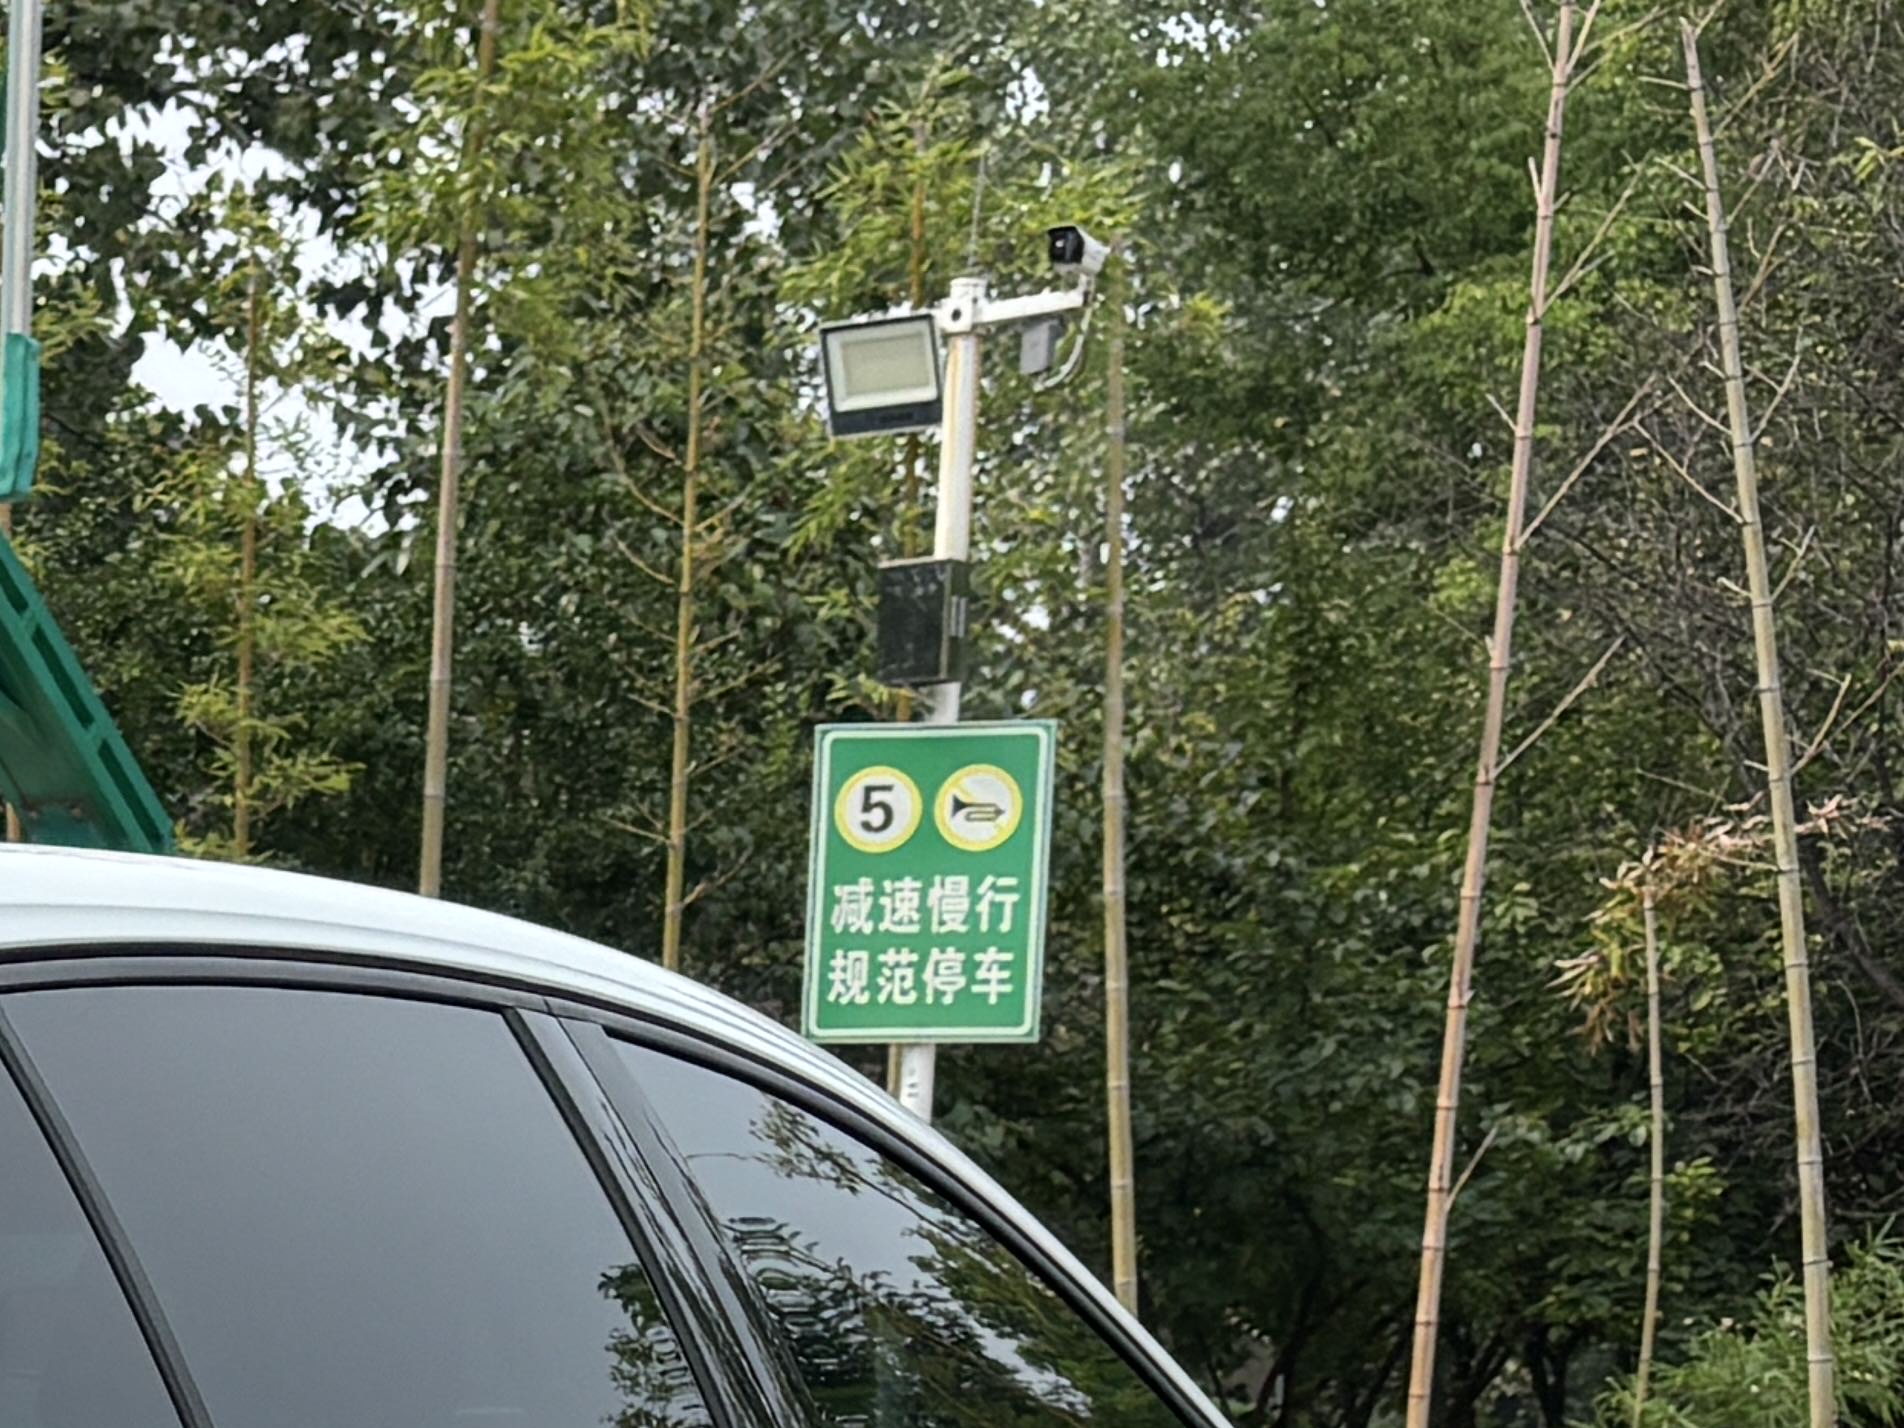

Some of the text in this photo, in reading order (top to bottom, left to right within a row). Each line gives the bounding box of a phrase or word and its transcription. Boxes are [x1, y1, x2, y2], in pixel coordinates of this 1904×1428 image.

[859, 784, 895, 834] 5
[830, 875, 1021, 934] 减速慢行
[826, 945, 1015, 1006] 规范停车
